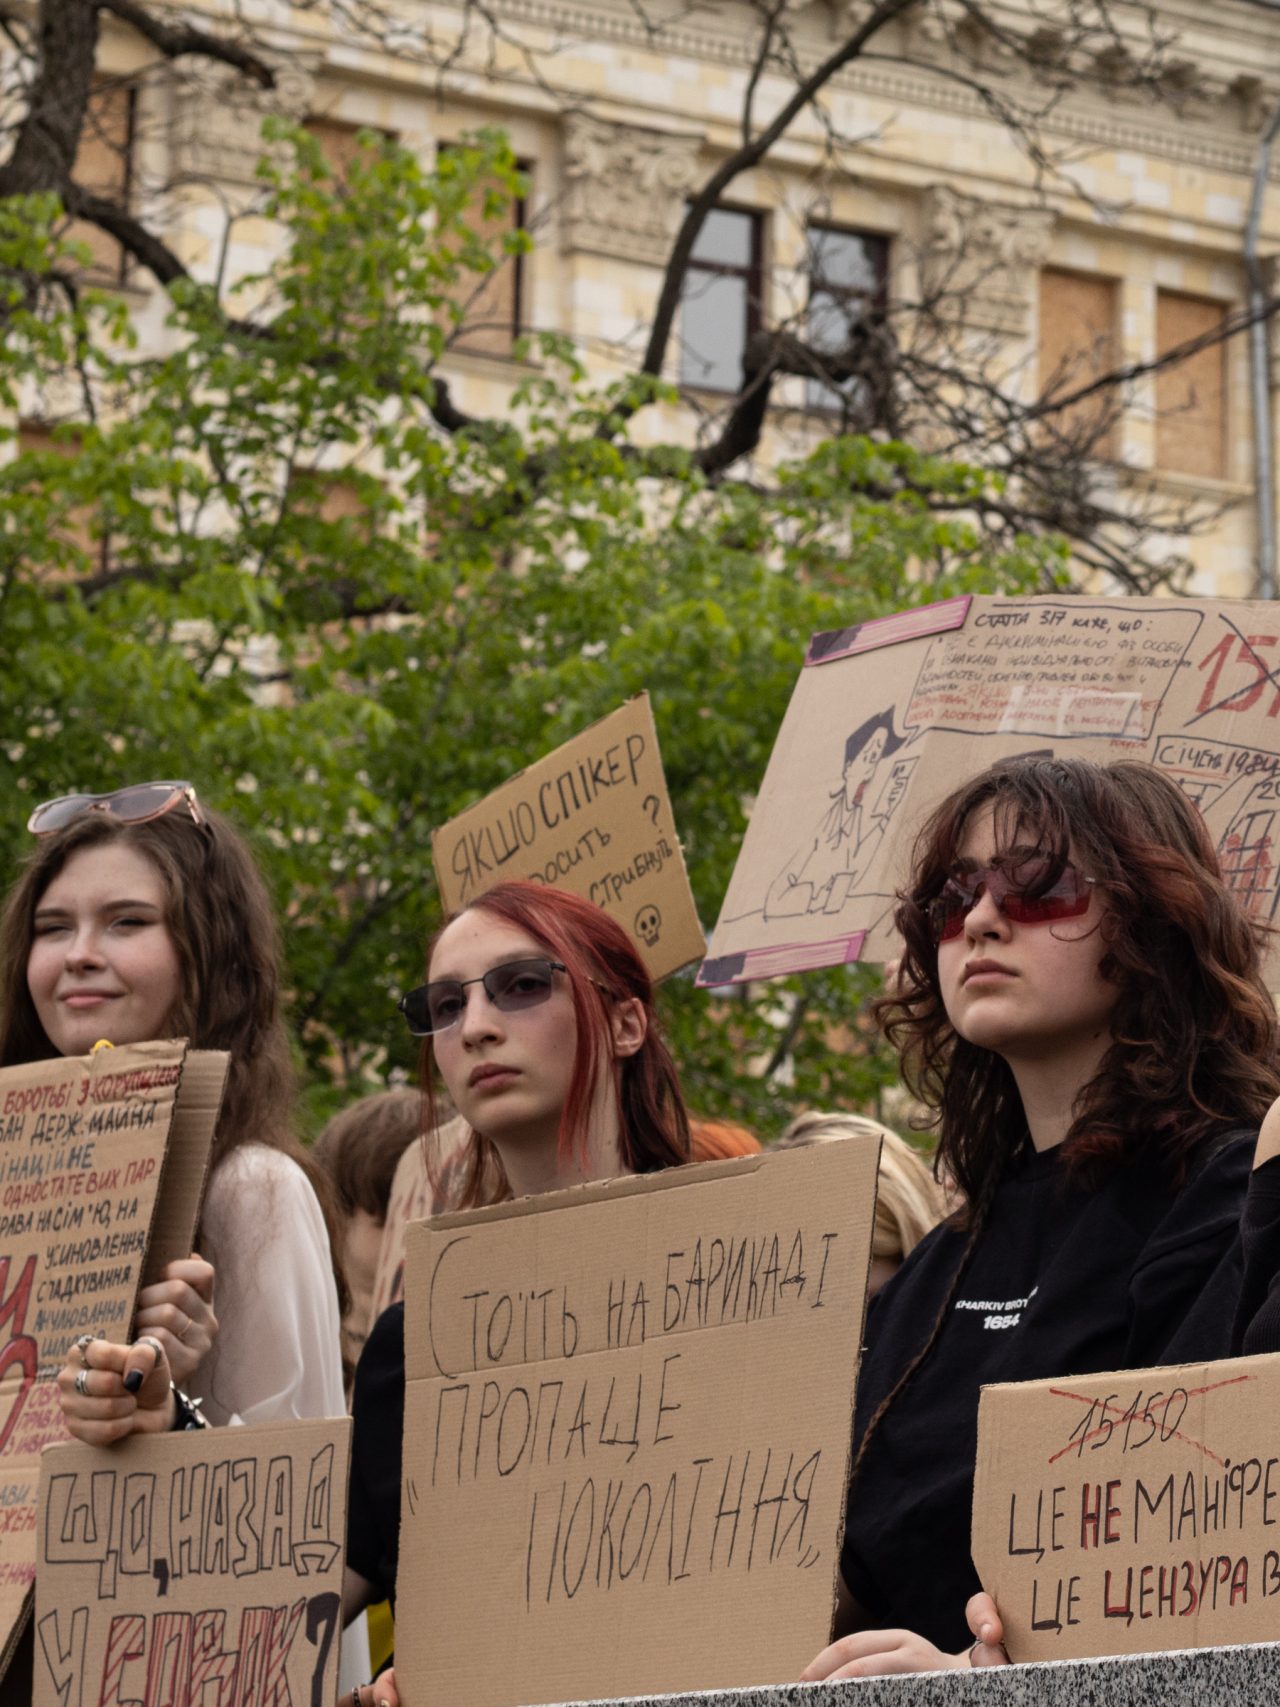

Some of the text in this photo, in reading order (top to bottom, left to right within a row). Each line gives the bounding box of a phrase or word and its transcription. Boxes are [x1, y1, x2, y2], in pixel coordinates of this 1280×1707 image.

[538, 734, 646, 829] СПІКЕР
[116, 1197, 138, 1221] НА
[124, 1158, 156, 1187] ПАР
[429, 1228, 839, 1379] СТОЇТЬ НА БАРИКАДІ
[955, 1299, 1004, 1311] KHARKIV
[984, 1312, 1021, 1329] 1654
[1068, 1387, 1189, 1458] 15150
[169, 1442, 342, 1578] НАЗАД
[1008, 1486, 1066, 1564] ЦЕ
[1080, 1479, 1122, 1550] НЕ
[1032, 1576, 1081, 1635] ЦЕ
[1104, 1556, 1249, 1627] ЦЕНЗУРА
